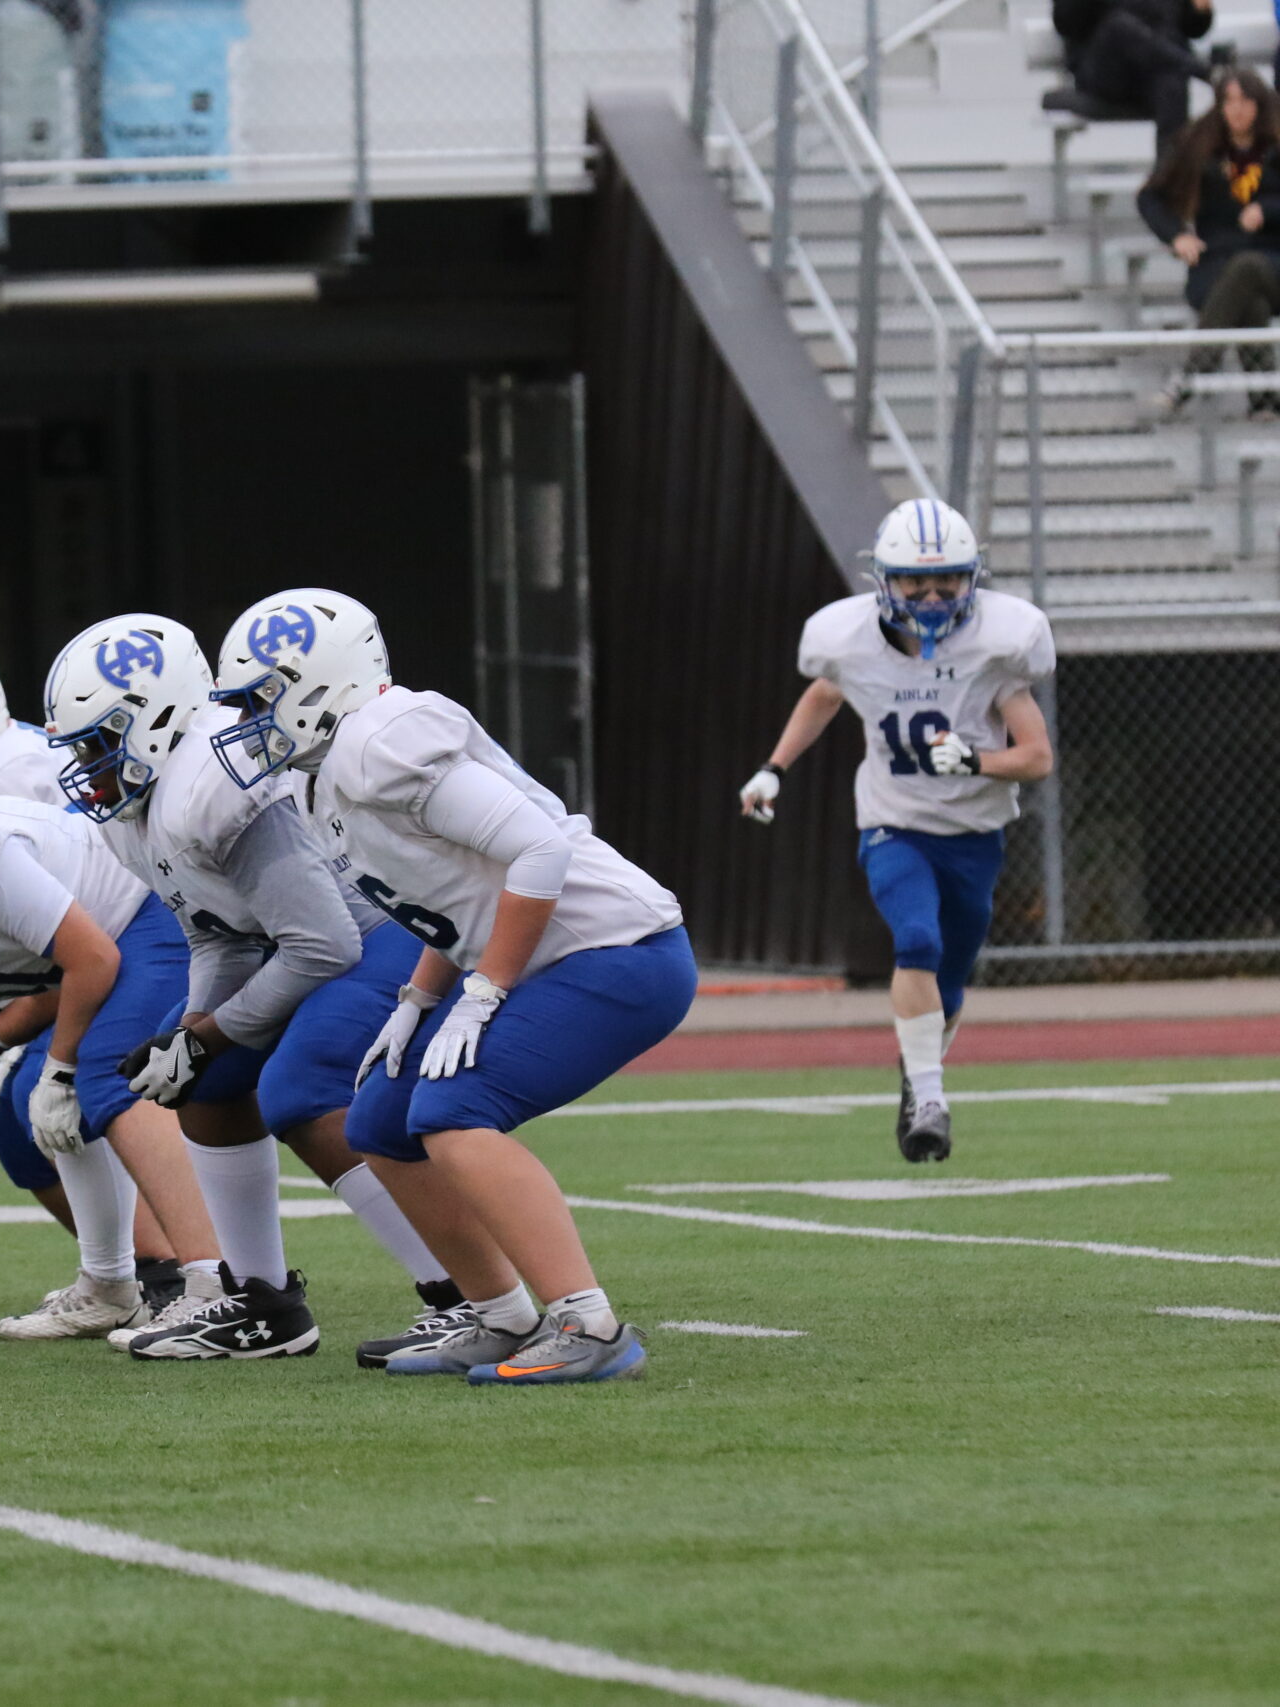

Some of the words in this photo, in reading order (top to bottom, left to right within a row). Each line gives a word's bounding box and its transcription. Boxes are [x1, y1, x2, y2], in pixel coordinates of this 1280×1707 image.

[894, 688, 940, 702] AINLAY
[165, 891, 187, 912] LAY
[349, 874, 461, 950] 6
